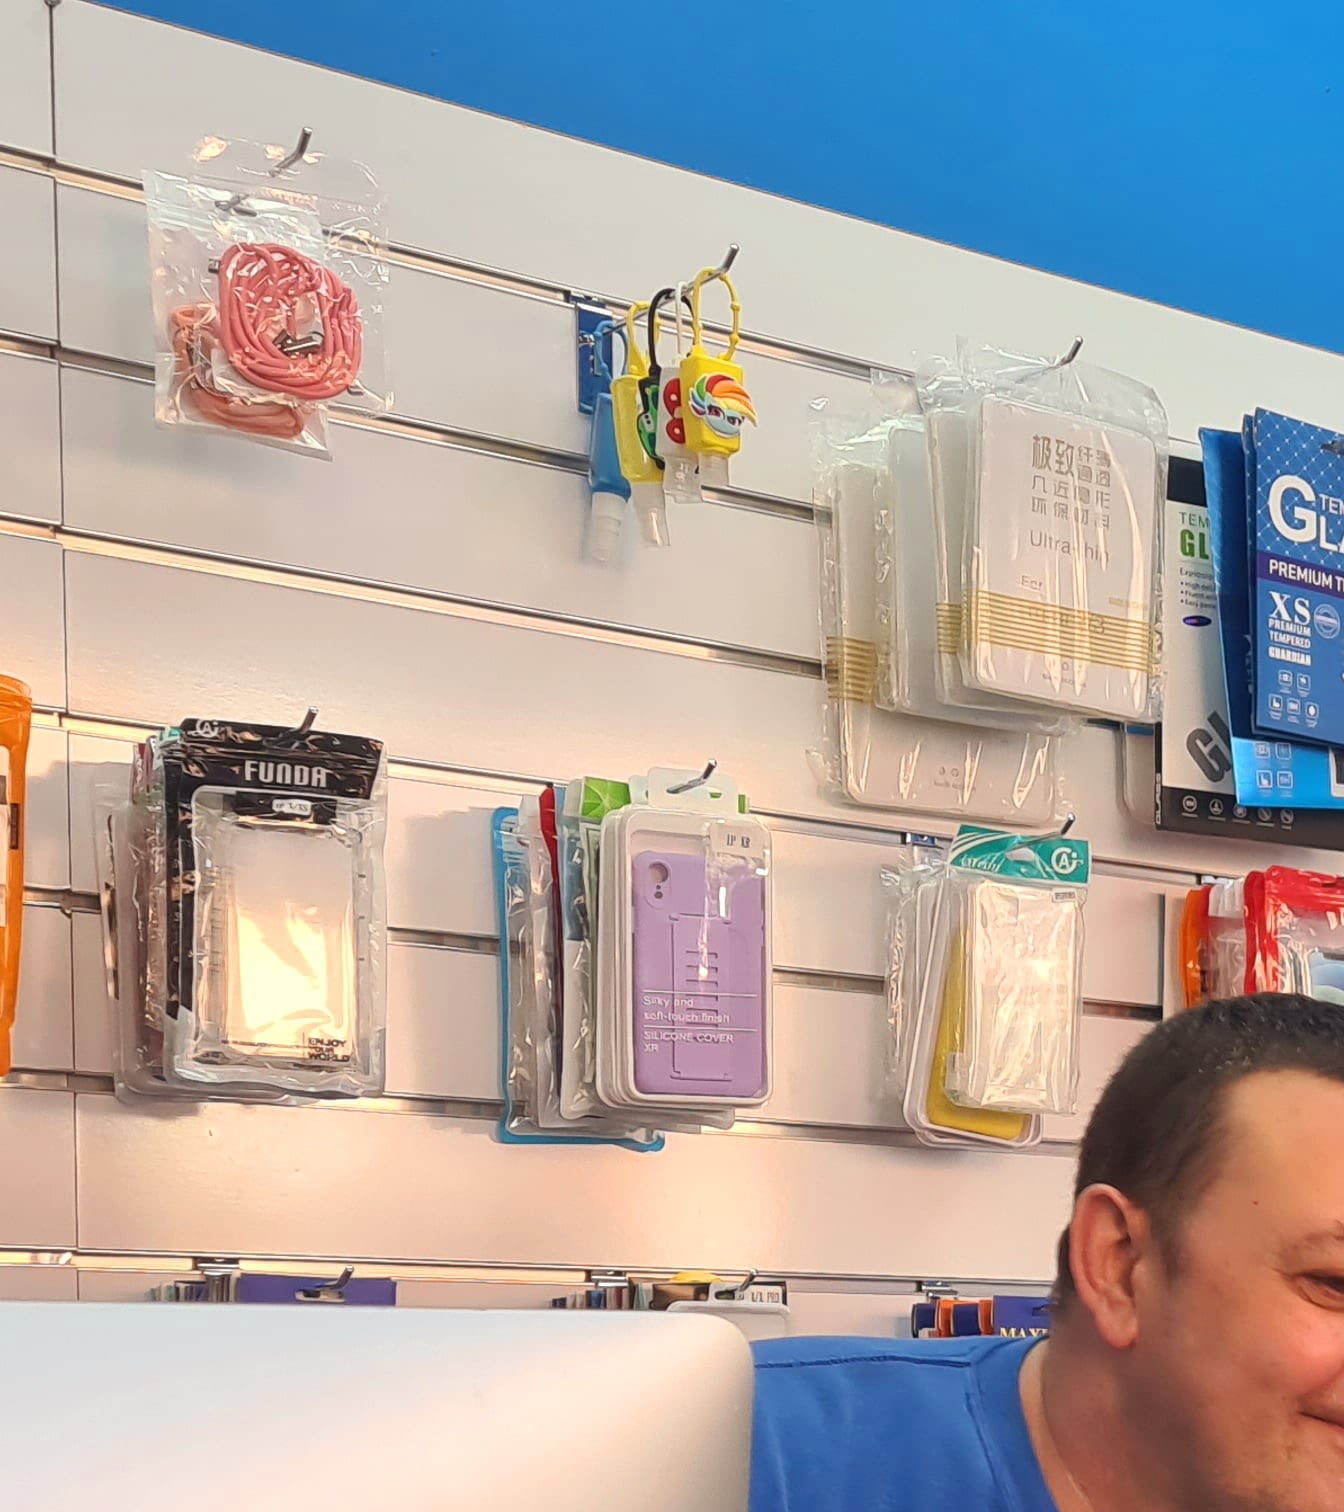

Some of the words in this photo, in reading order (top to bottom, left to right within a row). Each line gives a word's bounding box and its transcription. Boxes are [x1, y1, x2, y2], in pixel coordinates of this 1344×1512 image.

[1268, 558, 1333, 589] PREMIUM
[1268, 590, 1311, 626] XS
[1268, 618, 1312, 637] PREMIUM
[1268, 630, 1311, 650] TEMPERED
[244, 760, 327, 788] FUNDA
[696, 1034, 734, 1044] COVER
